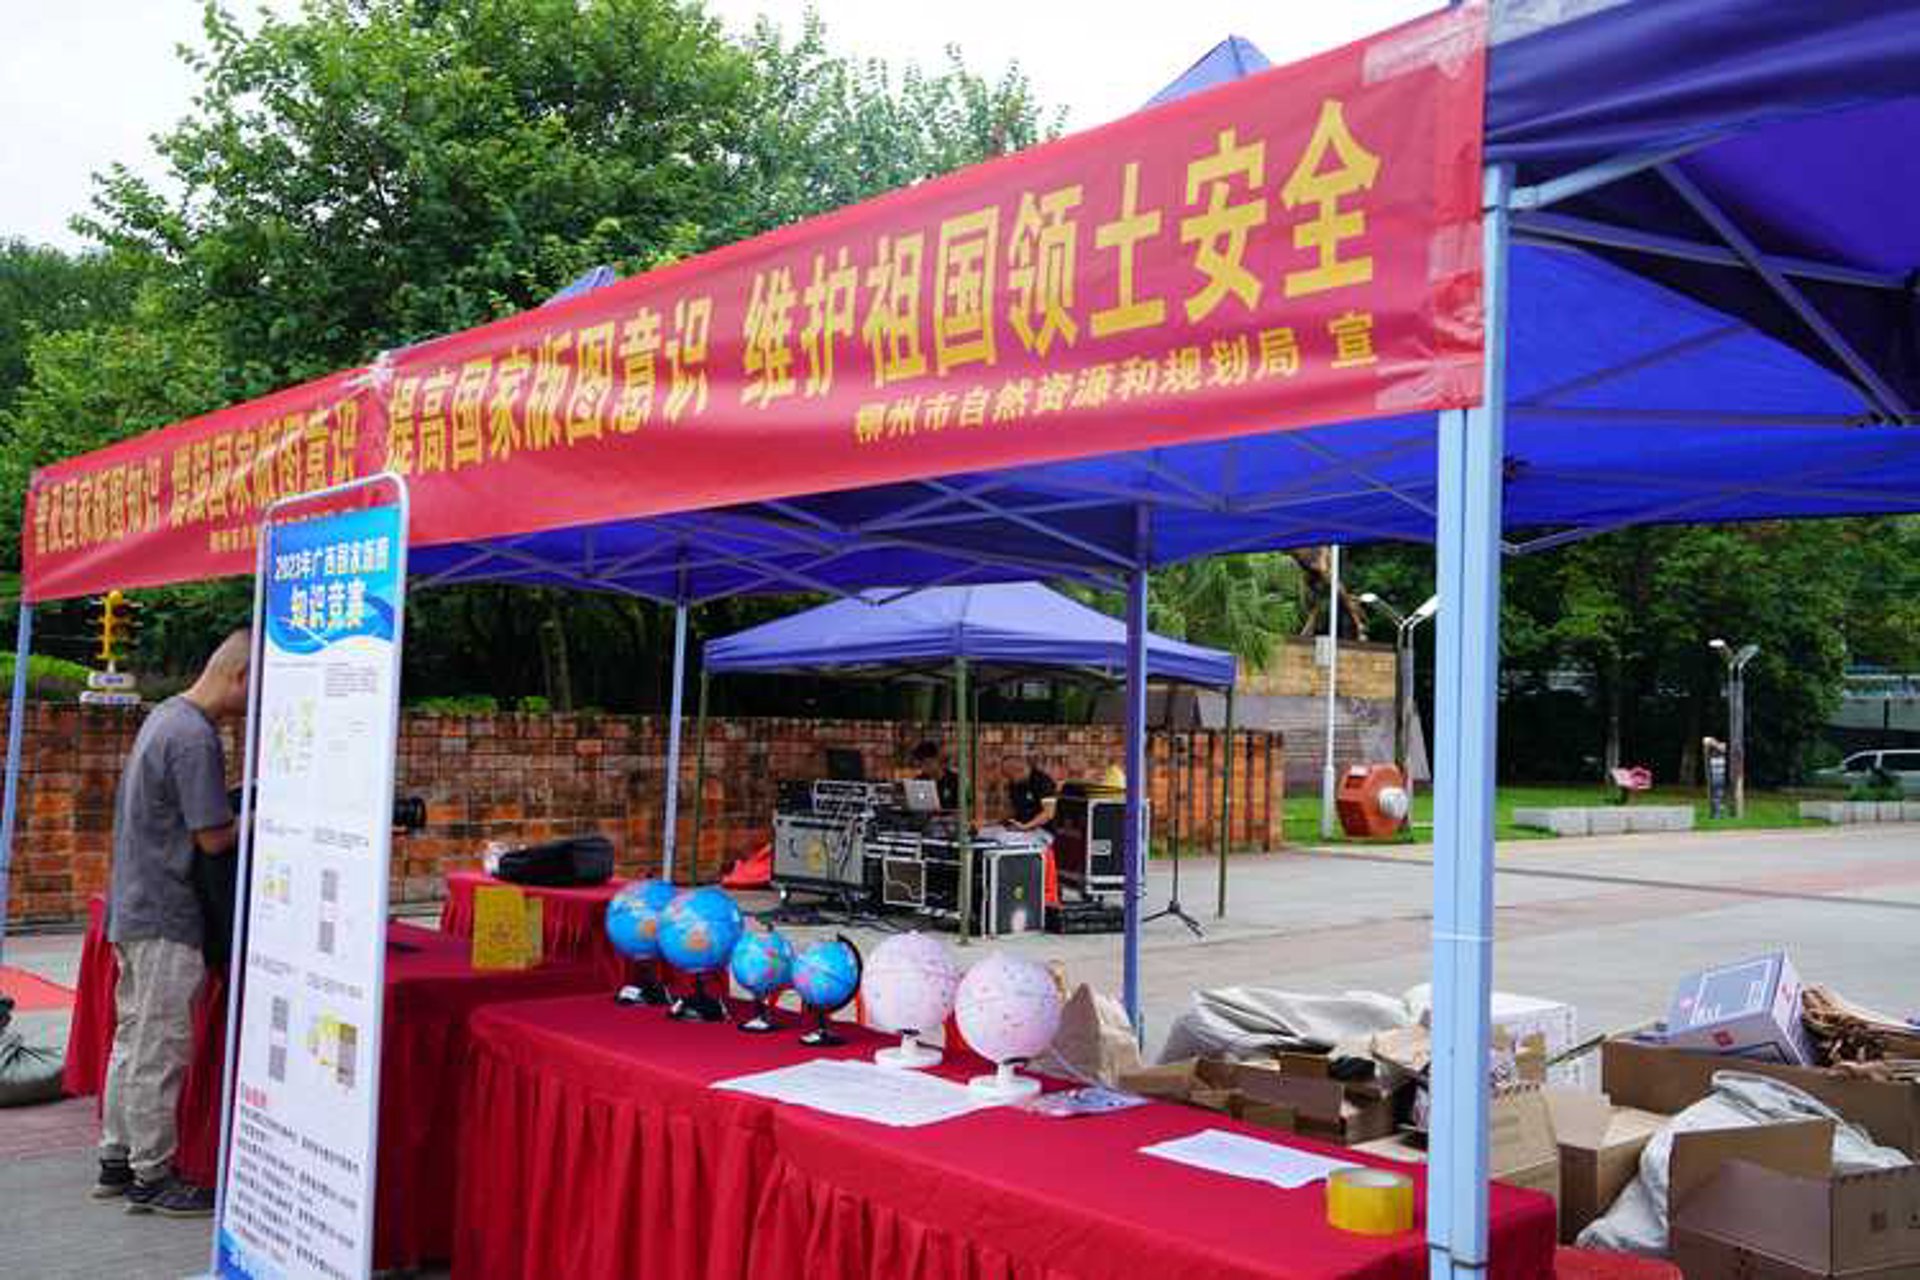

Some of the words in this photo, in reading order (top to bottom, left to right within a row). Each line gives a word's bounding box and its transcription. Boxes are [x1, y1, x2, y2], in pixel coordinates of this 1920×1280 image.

[385, 296, 713, 475] 提高国家版图意识
[740, 98, 1381, 408] 维护祖国领土安全
[853, 326, 1299, 444] 柳州市自然资源和规划局
[1330, 311, 1379, 371] 宣
[290, 577, 367, 630] 知识竞赛
